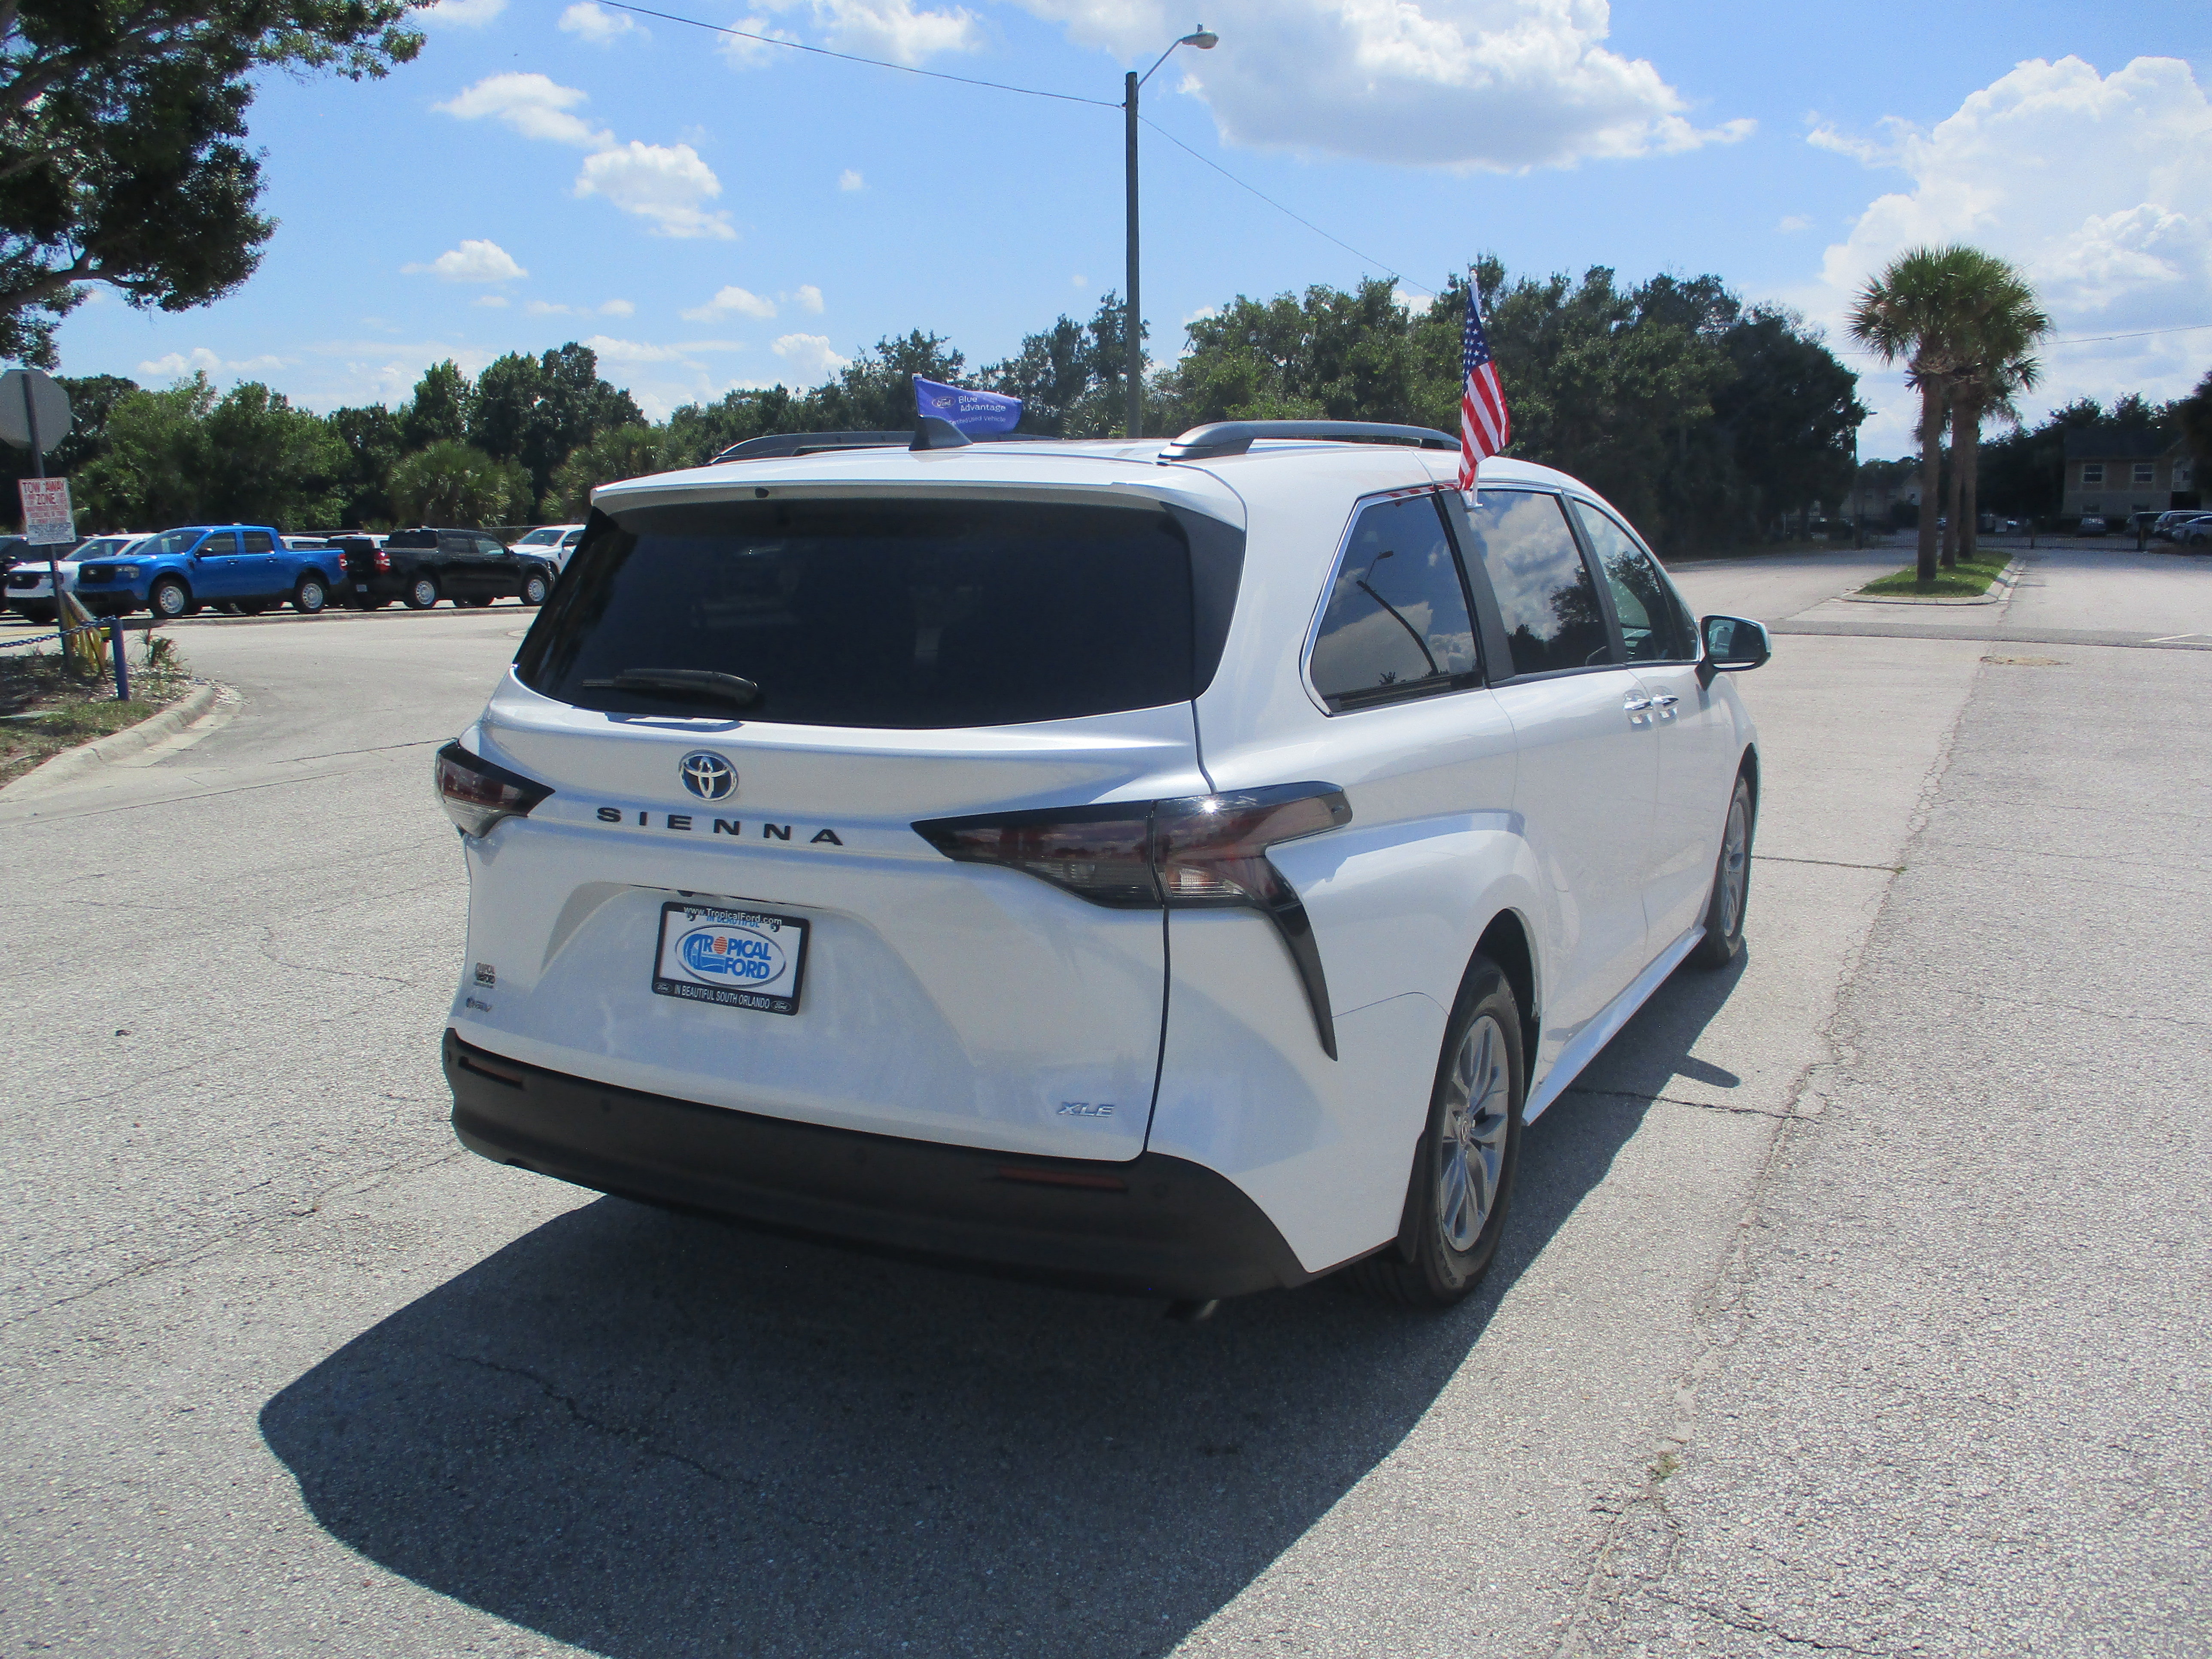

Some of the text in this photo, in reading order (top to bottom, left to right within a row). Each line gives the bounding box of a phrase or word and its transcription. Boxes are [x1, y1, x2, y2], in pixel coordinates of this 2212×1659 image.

[937, 398, 951, 407] Ford
[960, 404, 1006, 413] Advantage
[36, 493, 56, 505] ZONE
[596, 807, 844, 846] SIENNA
[684, 906, 782, 925] www.TropicalFord.com
[724, 957, 771, 979] FORD
[657, 983, 670, 991] Ford
[674, 984, 770, 1009] IN BEAUTIFUL SOUTH ORLANDO
[775, 1002, 788, 1010] Ford
[1058, 1101, 1115, 1118] XLE
